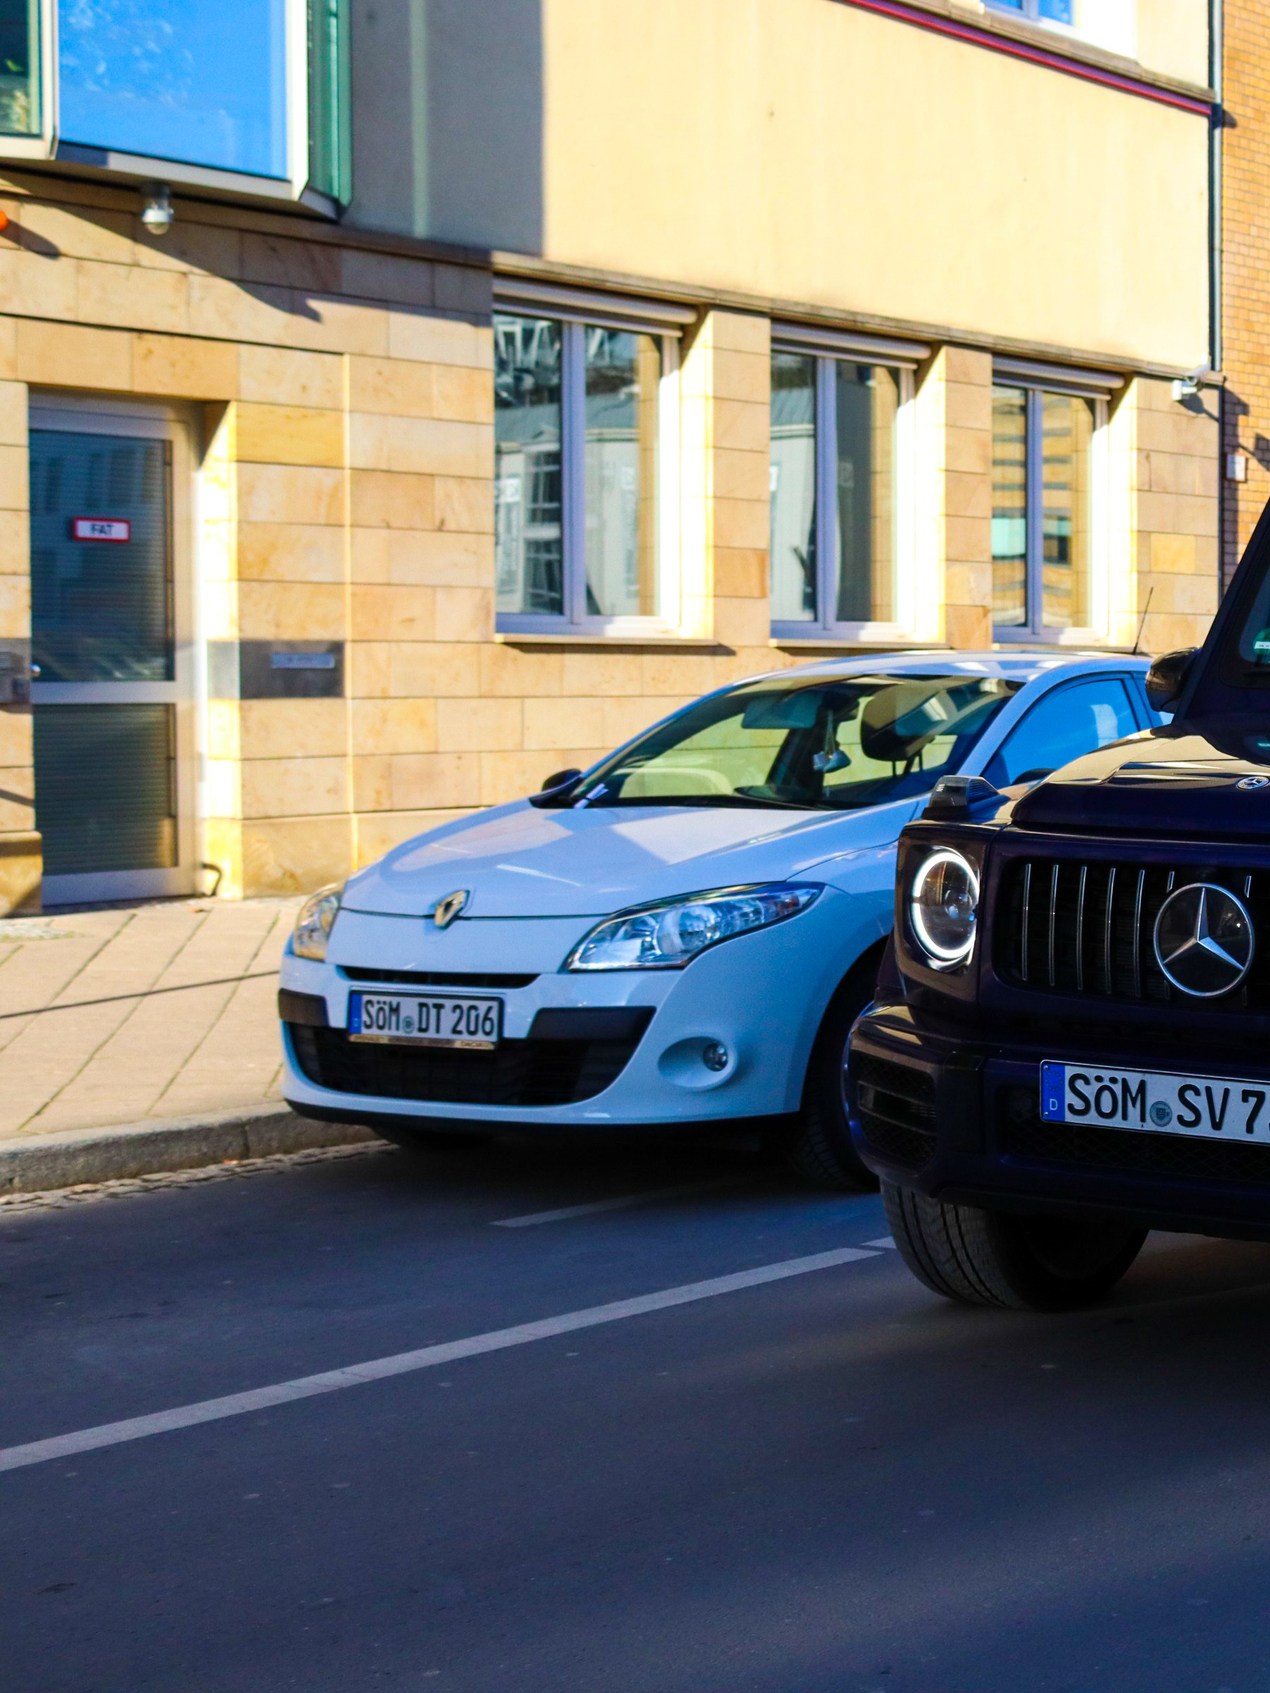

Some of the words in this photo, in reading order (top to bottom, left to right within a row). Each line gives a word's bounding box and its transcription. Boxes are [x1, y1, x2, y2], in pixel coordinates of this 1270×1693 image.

[363, 999, 400, 1032] SÖM
[417, 1002, 446, 1034] DT
[451, 1004, 495, 1036] 206
[1067, 1073, 1147, 1123] SÖM
[1176, 1083, 1231, 1132] SV
